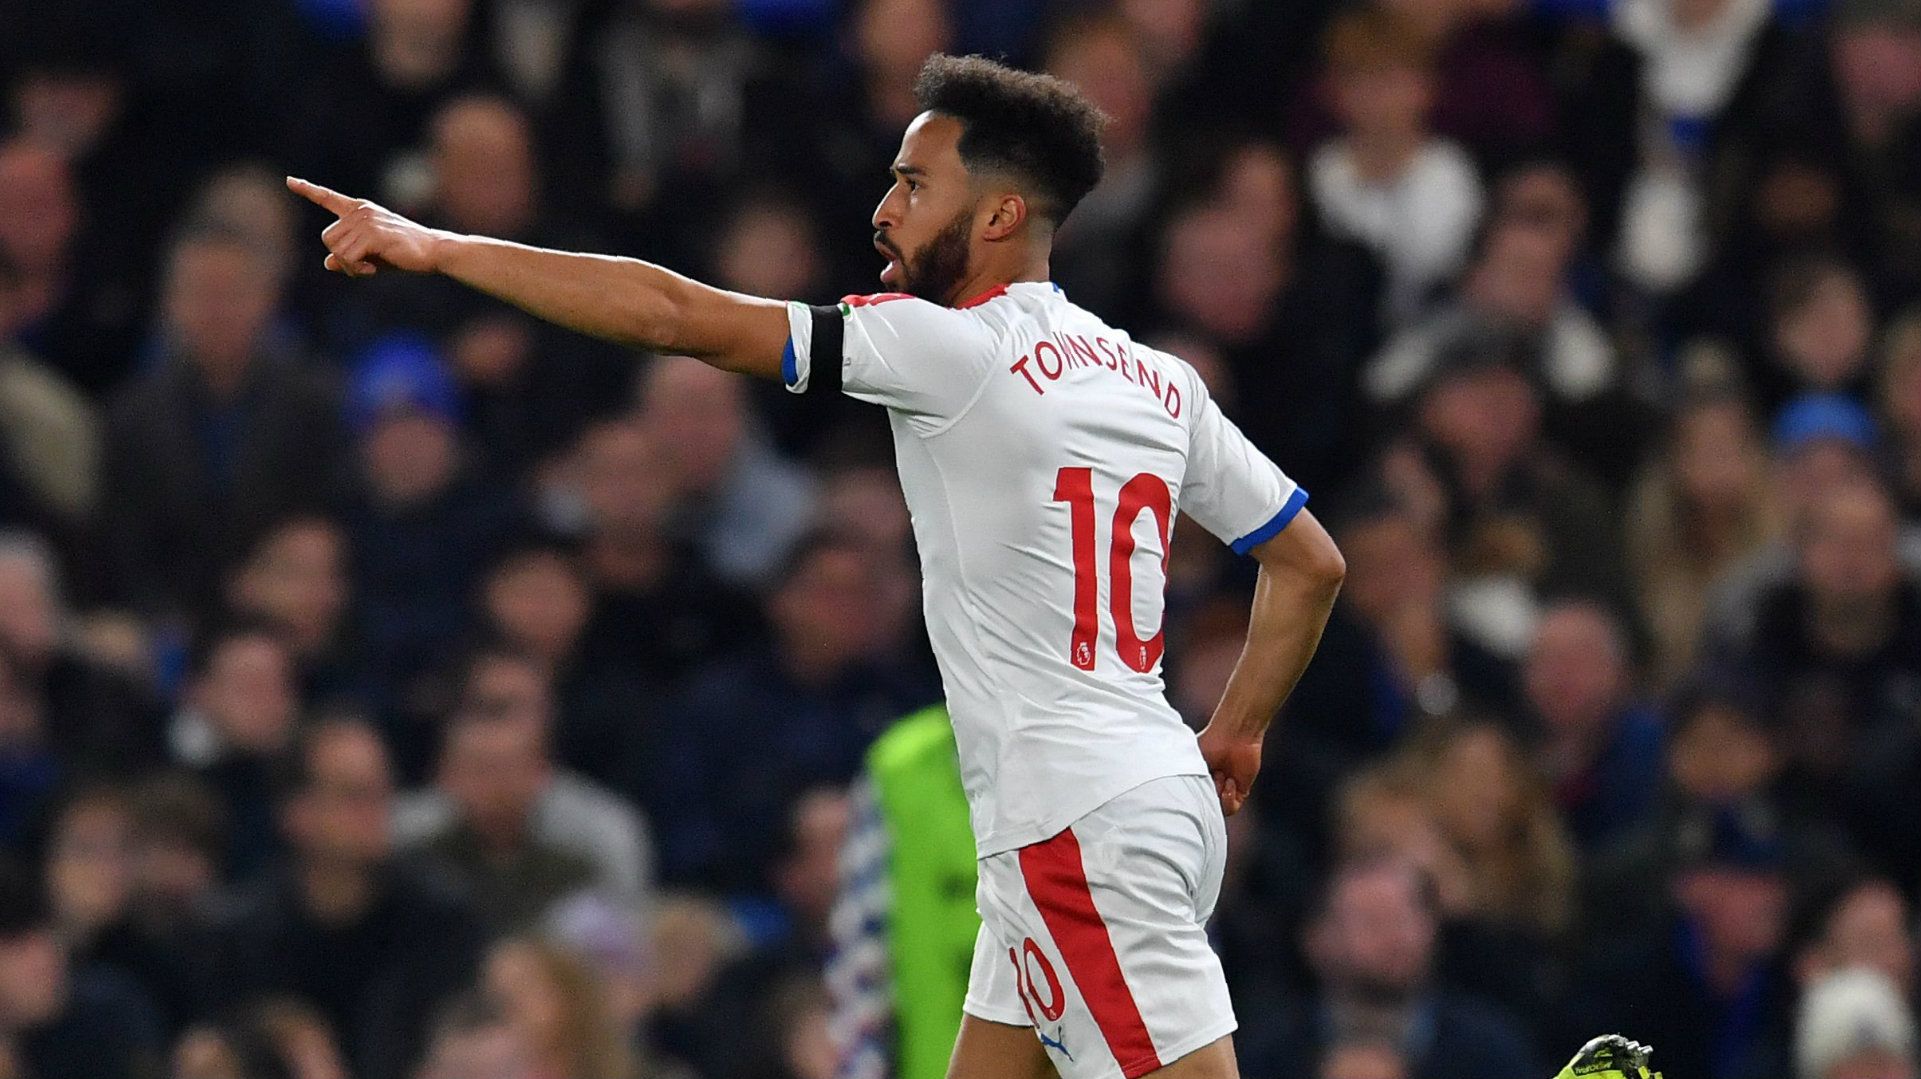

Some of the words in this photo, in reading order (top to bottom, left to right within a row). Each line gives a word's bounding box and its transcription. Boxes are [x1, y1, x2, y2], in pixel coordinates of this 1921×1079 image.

[1010, 331, 1181, 419] TOWNSEND
[1053, 466, 1172, 673] 10
[1009, 937, 1065, 1029] 10
